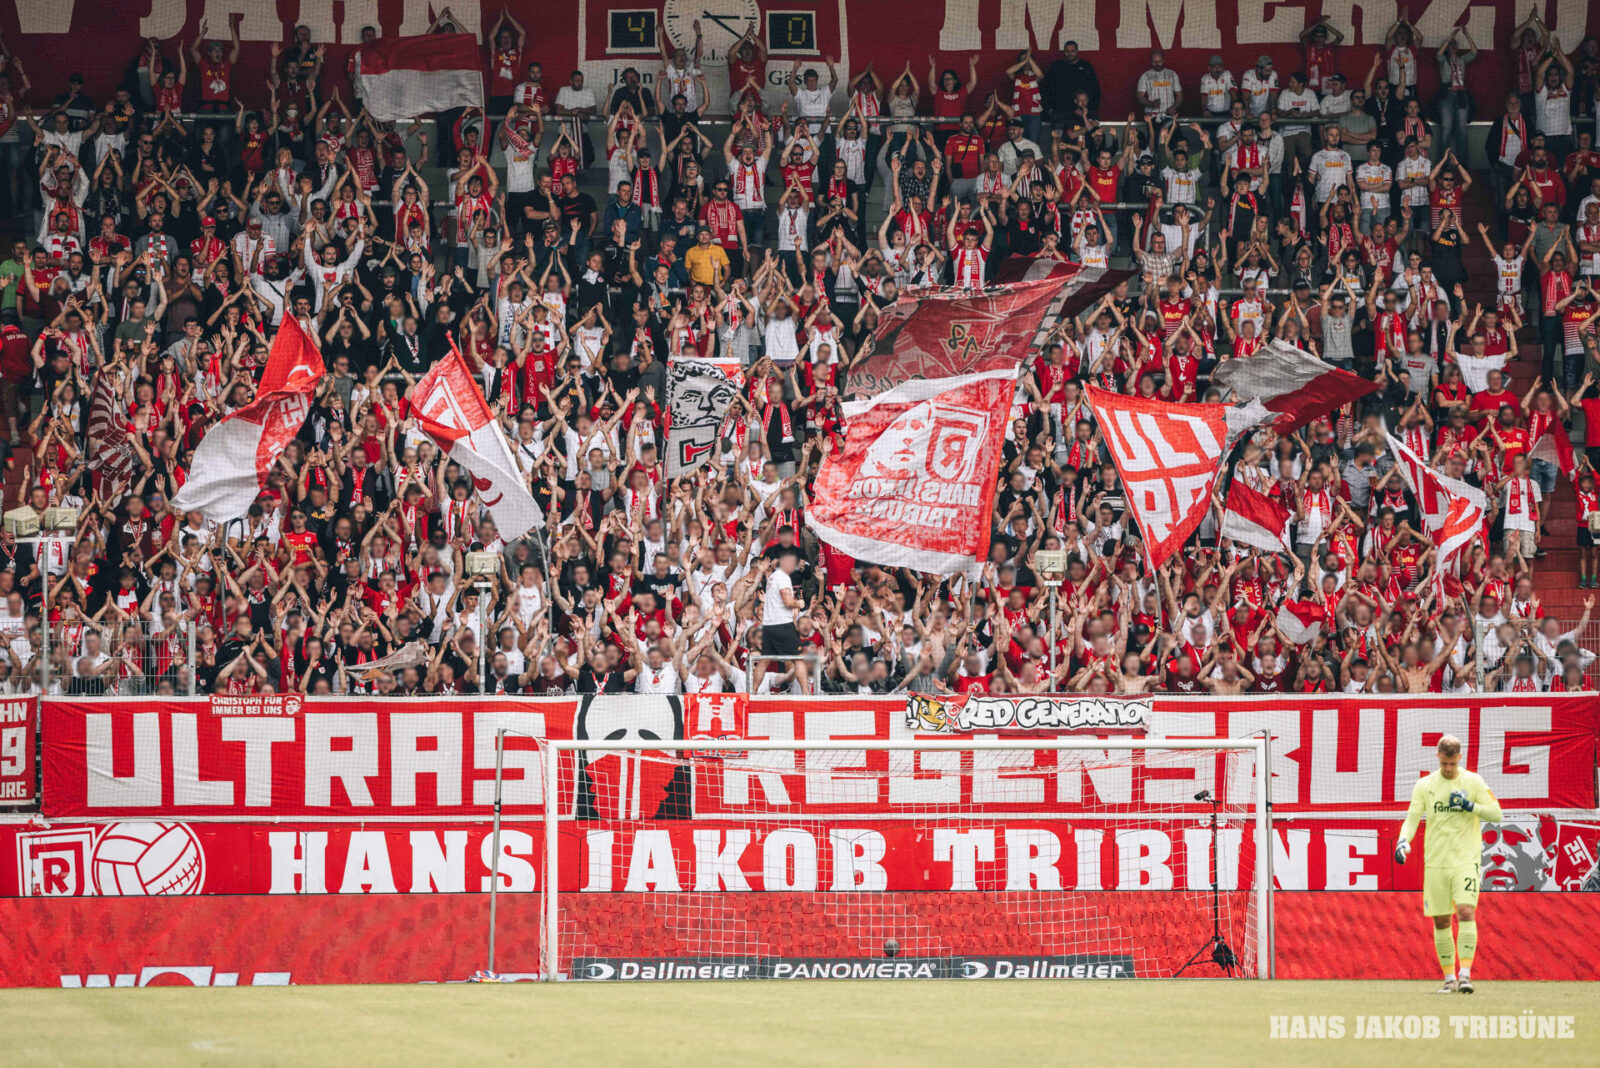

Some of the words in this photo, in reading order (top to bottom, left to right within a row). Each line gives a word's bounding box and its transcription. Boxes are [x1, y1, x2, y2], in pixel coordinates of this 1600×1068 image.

[627, 16, 646, 43] 4
[788, 16, 806, 45] 0
[613, 68, 653, 86] Jn
[769, 67, 804, 86] Gäs
[211, 696, 262, 705] CHRISTOPH
[211, 706, 243, 715] IMMER
[246, 706, 261, 715] BEI
[263, 706, 283, 715] UNS
[956, 698, 1015, 729] RED
[1016, 698, 1154, 730] GENERATION
[86, 711, 546, 808] ULTRAS
[268, 829, 536, 894] HANS
[579, 828, 888, 893] JAKOB
[932, 818, 1379, 892] TRIBÜNE
[1464, 877, 1477, 892] 21
[619, 961, 750, 980] Dallmeier
[993, 960, 1123, 979] Dallmeier
